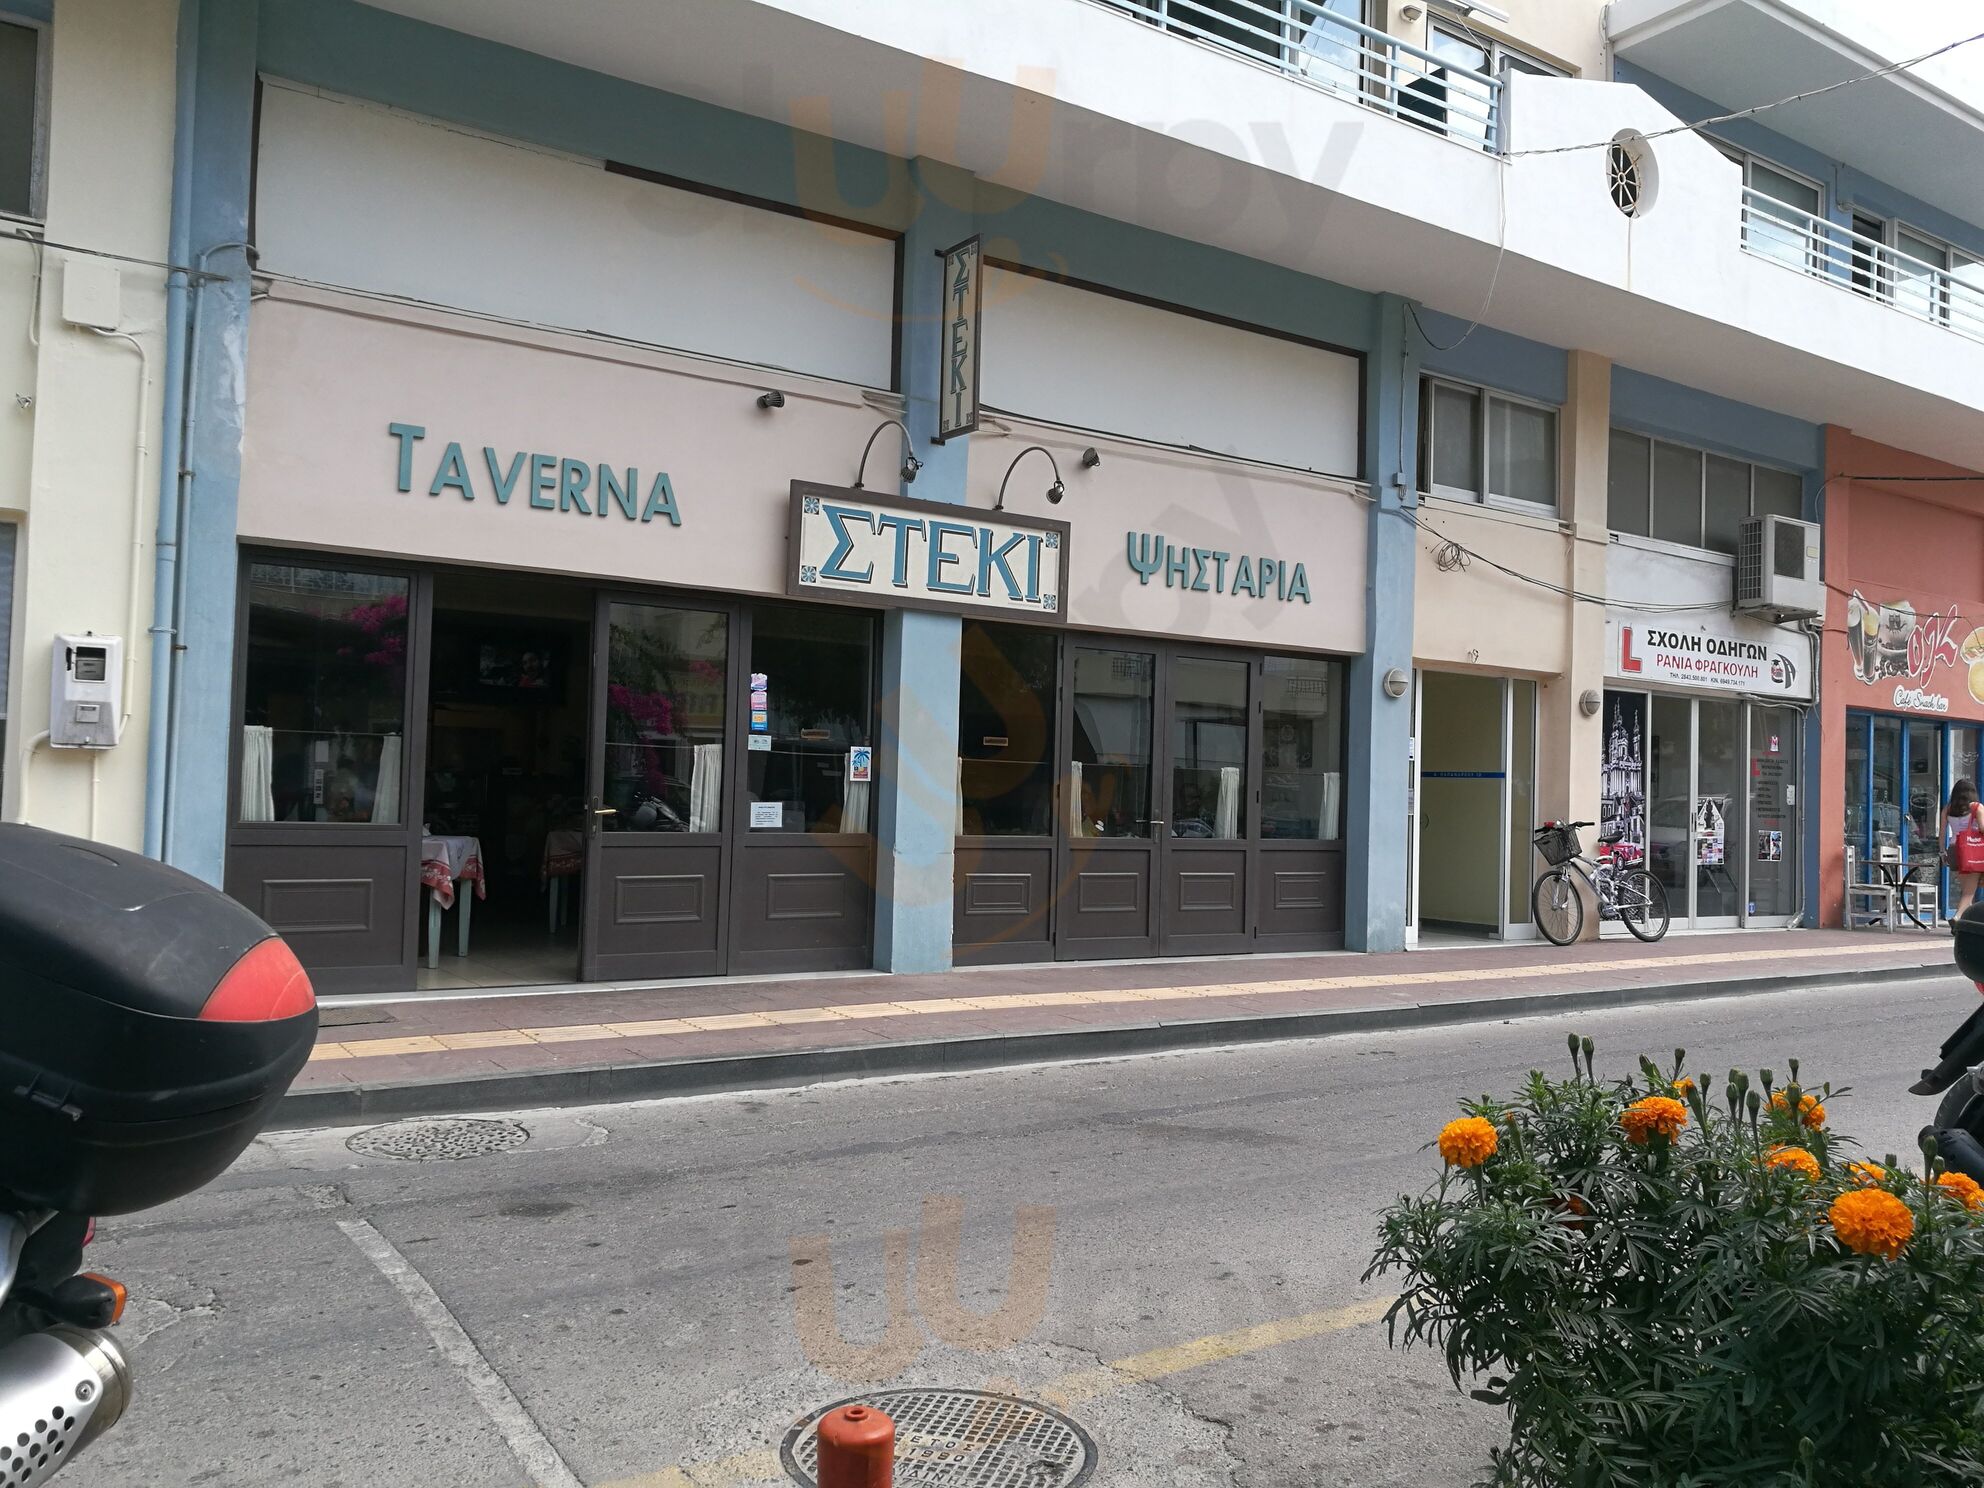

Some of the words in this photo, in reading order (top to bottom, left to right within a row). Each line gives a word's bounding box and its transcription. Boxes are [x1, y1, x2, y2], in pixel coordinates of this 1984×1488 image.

[950, 250, 971, 428] ΣΤΕΚΙ
[389, 422, 682, 528] TAVERNA
[818, 503, 1045, 604] ΣΤΕΚΙ
[1126, 530, 1313, 605] ΨΗΣΤΑΡΙΑ
[1622, 627, 1643, 673] L
[1647, 629, 1702, 653] ΣΧΟΛΗ
[1706, 637, 1768, 662] ΟΔΗΓΩΝ
[1656, 653, 1693, 671] ΡΑΝΙΑ
[1694, 658, 1759, 679] ΦΡΑΓΚΟΥΛΗ
[910, 1435, 975, 1452] ΕΤΟΣ
